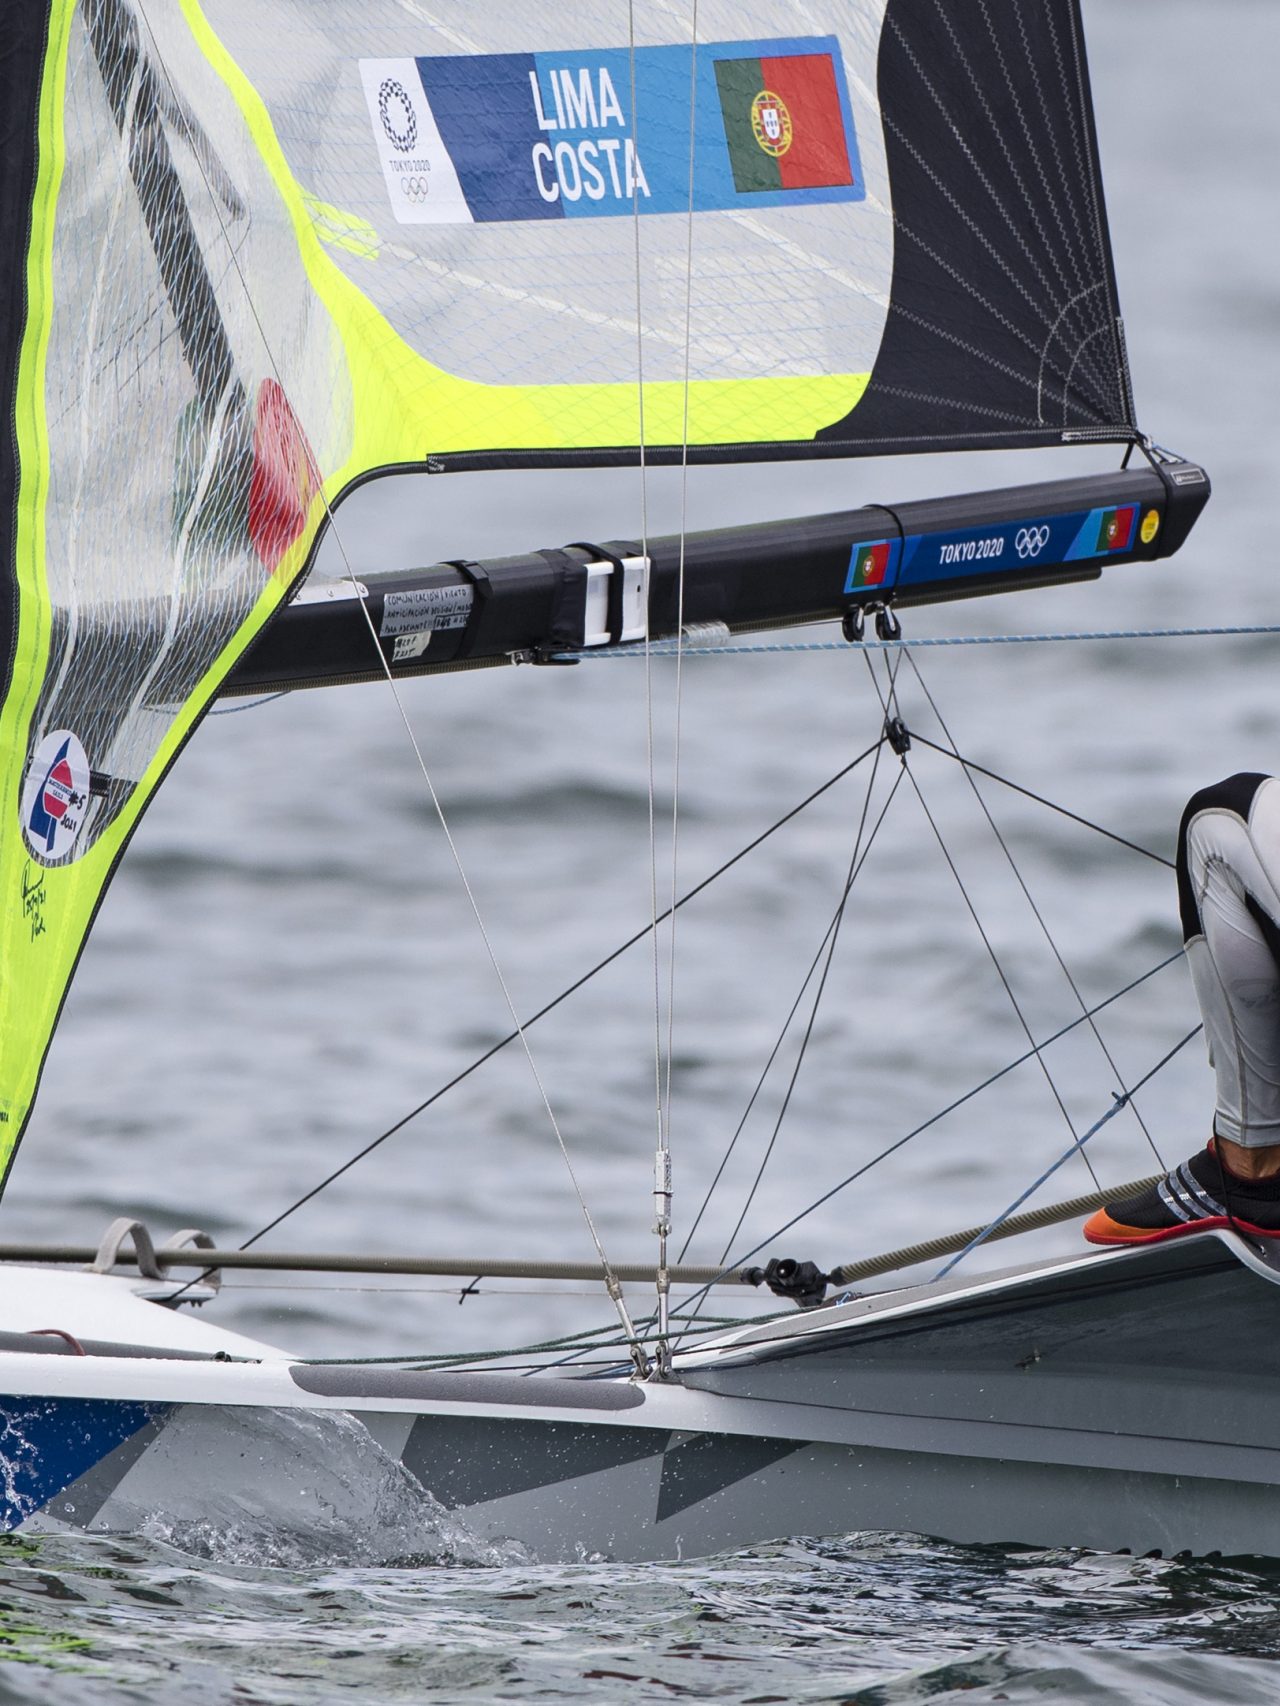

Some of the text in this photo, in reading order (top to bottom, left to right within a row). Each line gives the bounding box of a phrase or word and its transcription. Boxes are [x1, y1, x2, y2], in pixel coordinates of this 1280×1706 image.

[528, 67, 625, 131] LIMA
[389, 159, 431, 172] TOKYO 2020
[532, 138, 651, 202] COSTA
[939, 537, 1004, 565] TOKYO 2020
